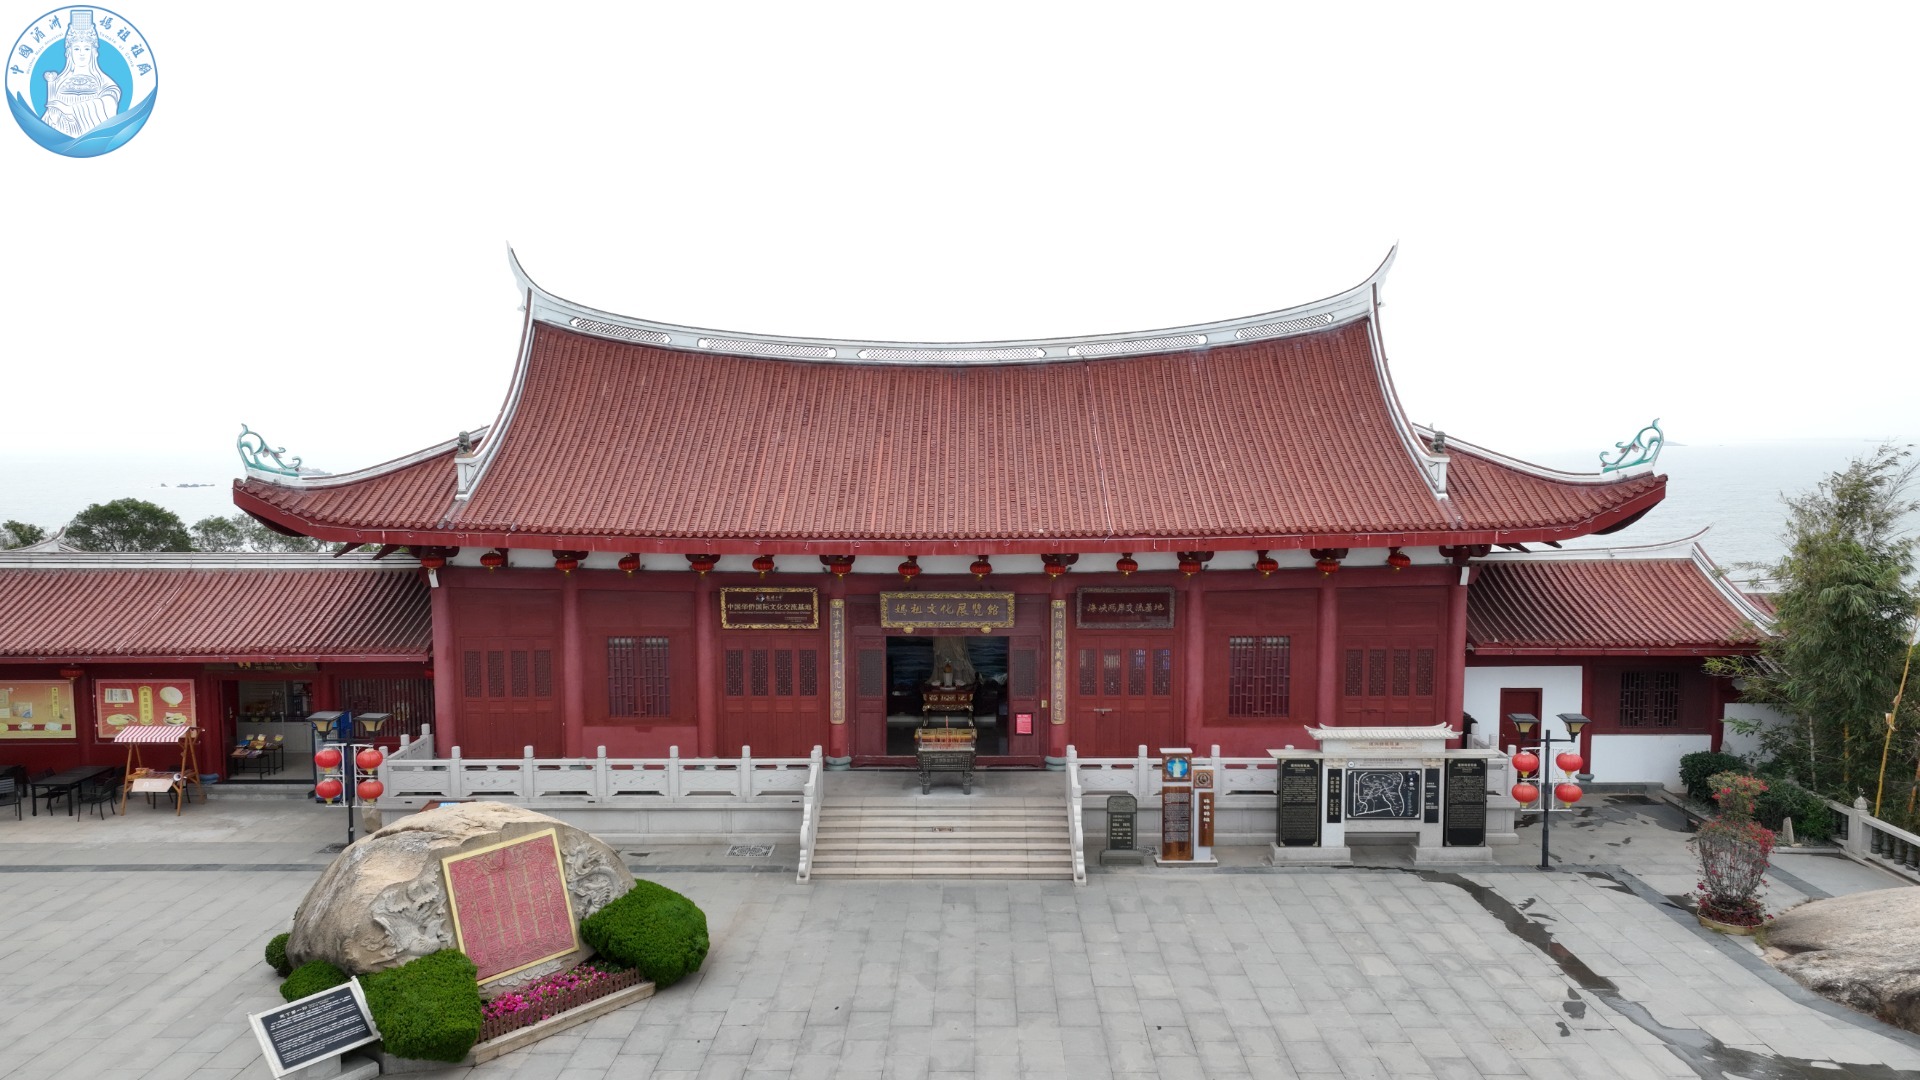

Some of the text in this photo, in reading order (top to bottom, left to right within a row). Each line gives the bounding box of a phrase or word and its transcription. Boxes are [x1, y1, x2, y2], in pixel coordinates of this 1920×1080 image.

[727, 603, 812, 611] 中国华侨国际文化交流基地
[894, 602, 999, 617] 媽祖文化展覽館
